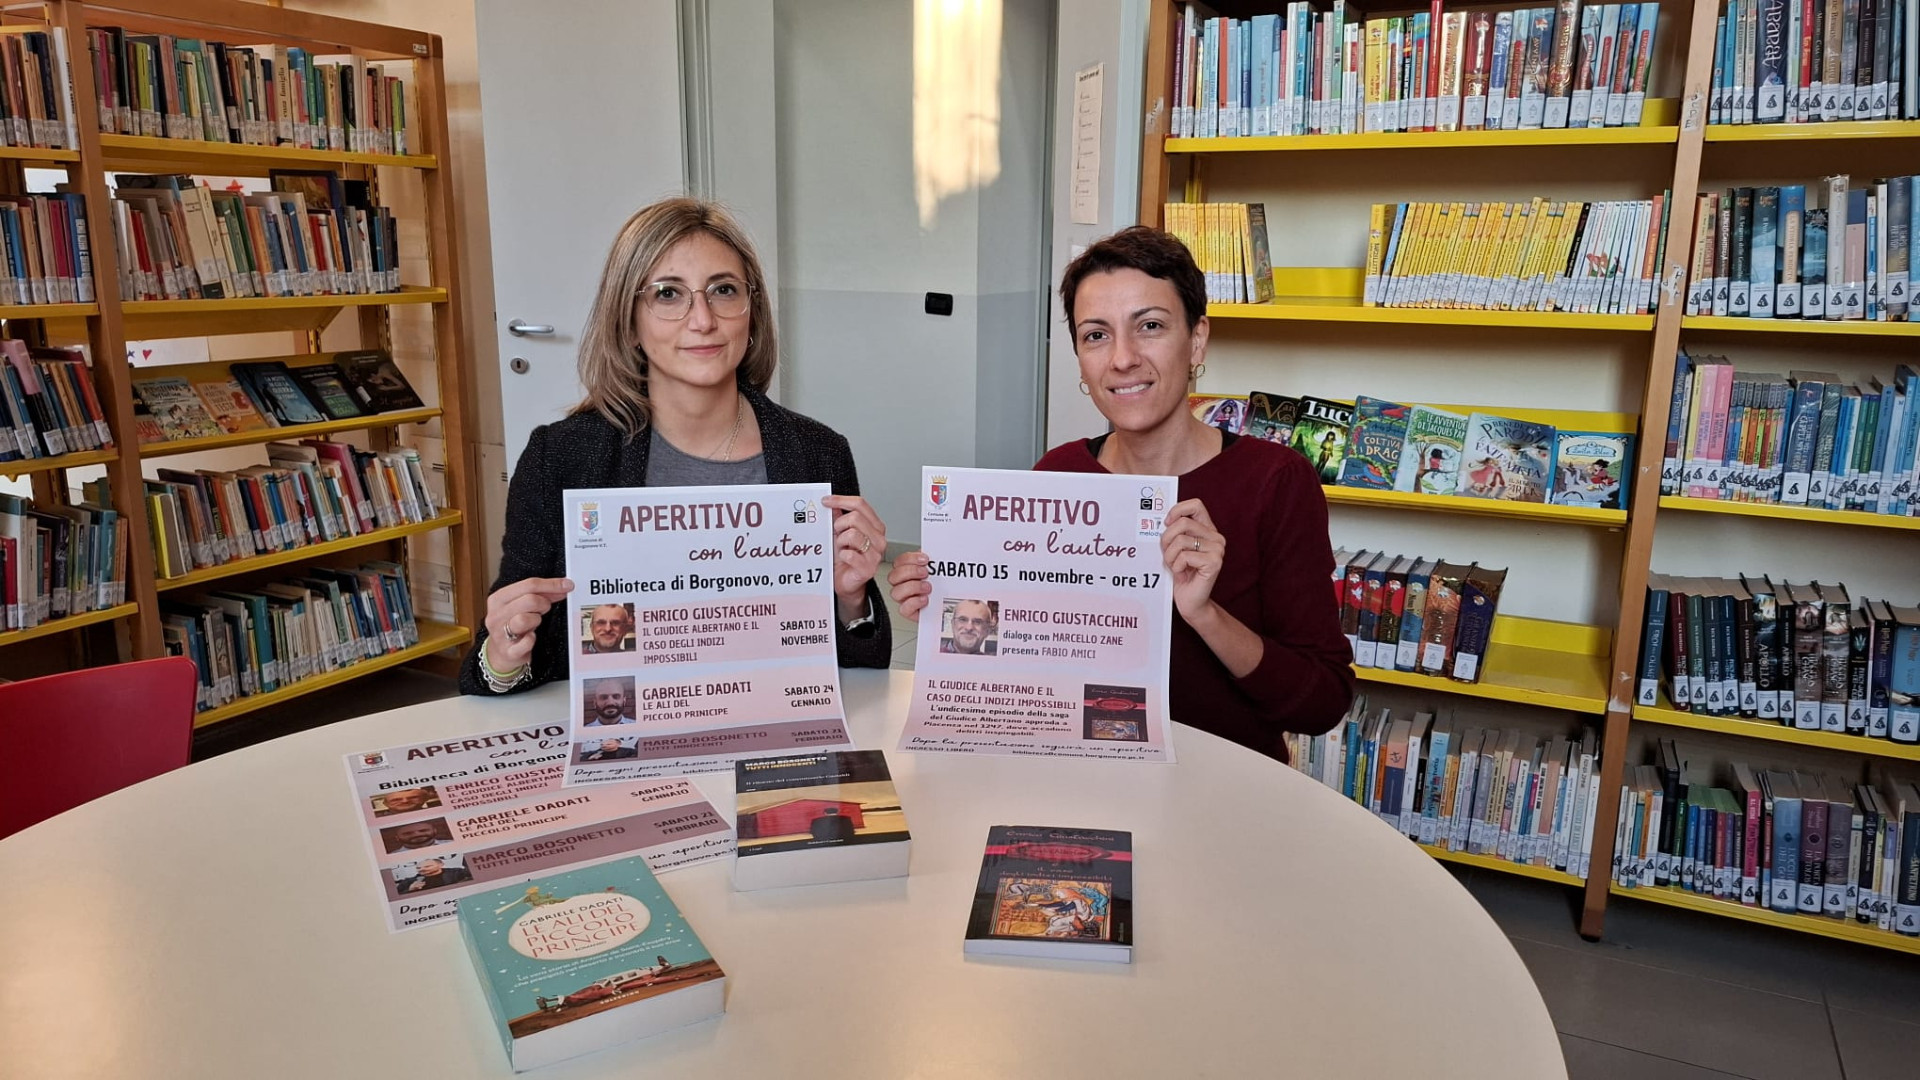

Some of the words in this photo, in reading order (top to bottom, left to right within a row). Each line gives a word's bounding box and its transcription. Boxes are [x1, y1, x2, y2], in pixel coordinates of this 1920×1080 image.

[1434, 415, 1467, 429] AVVENTUR
[1364, 437, 1402, 451] COLTIVA
[1366, 446, 1399, 459] DRAG
[619, 502, 763, 532] APERITIVO
[962, 494, 1100, 526] APERITIVO
[689, 546, 722, 561] con
[734, 532, 822, 560] l'autore
[1004, 538, 1036, 553] con
[1046, 528, 1137, 559] l'autore
[590, 574, 665, 595] Biblioteca
[671, 576, 684, 590] di
[689, 572, 774, 592] Borgonovo,
[778, 572, 802, 584] ore
[807, 568, 823, 583] 17
[928, 561, 987, 579] SABATO
[992, 564, 1008, 580] 15
[1018, 568, 1094, 586] novembre
[1112, 574, 1138, 588] ore
[1142, 573, 1160, 589] 17
[643, 608, 689, 622] ENRICO
[692, 604, 776, 619] GIUSTACCHINI
[1004, 608, 1048, 624] ENRICO
[1052, 612, 1138, 629] GIUSTACCHINI
[643, 626, 651, 636] IL
[654, 624, 690, 636] GIUDICE
[692, 622, 740, 634] ALBERTANO
[743, 622, 749, 630] E
[751, 620, 760, 630] IL
[780, 620, 817, 632] SABATO
[818, 619, 828, 630] 15
[643, 640, 667, 650] CASO
[669, 638, 696, 650] DEGLI
[697, 636, 725, 648] INDIZI
[781, 634, 829, 646] NOVEMBRE
[1002, 631, 1032, 644] dialoga
[1034, 634, 1050, 642] con
[1052, 632, 1098, 645] MARCELLO
[1100, 635, 1124, 646] ZANE
[643, 652, 698, 665] IMPOSSIBILI
[1002, 646, 1040, 657] presenta
[1042, 646, 1068, 658] FABIO
[1070, 648, 1096, 659] AMICI
[1782, 646, 1790, 676] APOLLO
[1758, 643, 1770, 688] APOLLO
[642, 684, 703, 701] GABRIELE
[706, 682, 752, 696] DADATI
[784, 686, 820, 696] SABATO
[823, 684, 834, 694] 24
[928, 680, 938, 689] IL
[940, 680, 978, 692] GIUDICE
[980, 683, 1034, 696] ALBERTANO
[1037, 686, 1044, 696] E
[1046, 687, 1055, 697] IL
[643, 702, 654, 710] LE
[656, 700, 671, 710] ALI
[674, 700, 690, 708] DEL
[791, 698, 831, 708] GENNAIO
[926, 692, 952, 703] CASO
[953, 694, 982, 705] DEGLI
[984, 696, 1016, 706] INDIZI
[1018, 698, 1076, 710] IMPOSSIBILI
[643, 712, 682, 722] PICCOLO
[684, 708, 728, 718] PRINICIPE
[930, 704, 986, 715] L'undicesimo
[989, 708, 1024, 718] episodio
[980, 716, 1022, 724] Albertano
[1025, 718, 1060, 726] approda
[643, 738, 687, 747] MARCO
[691, 732, 768, 744] BOSONETTO
[792, 729, 828, 737] SABATO
[407, 725, 565, 760] APERITIVO
[912, 736, 937, 745] Dopo
[960, 739, 1035, 748] presentazione
[489, 748, 527, 760] con
[379, 769, 468, 791] Biblioteca
[473, 764, 489, 774] di
[445, 776, 500, 792] ENRICO
[461, 784, 501, 796] GIUDICE
[506, 773, 565, 788] ALBERTANO
[450, 794, 474, 804] CASO
[476, 788, 512, 800] DEGLI
[514, 782, 549, 794] INDIZI
[630, 784, 674, 798] SABATO
[642, 788, 690, 802] GENNAIO
[453, 794, 519, 810] IMPOSSIBILI
[456, 808, 532, 828] GABRIELE
[535, 796, 592, 812] DADATI
[653, 814, 698, 828] SABATO
[700, 810, 715, 819] 21
[462, 826, 511, 840] PICCOLO
[513, 814, 568, 830] PRINICIPE
[477, 822, 494, 830] ALI
[500, 817, 518, 826] DEL
[662, 818, 719, 836] FEBBRAIO
[471, 846, 528, 865] MARCO
[532, 826, 626, 852] BOSONETTO
[475, 859, 510, 871] TUTTI
[513, 844, 576, 864] INNOCENTI
[400, 903, 438, 914] Dopo
[519, 909, 576, 926] GABRIELE
[580, 896, 624, 911] DADATI
[522, 924, 541, 936] LE
[552, 914, 584, 930] ALI
[590, 904, 628, 920] DEL
[527, 912, 634, 947] PICCOLO
[532, 924, 640, 958] PRINCIPE
